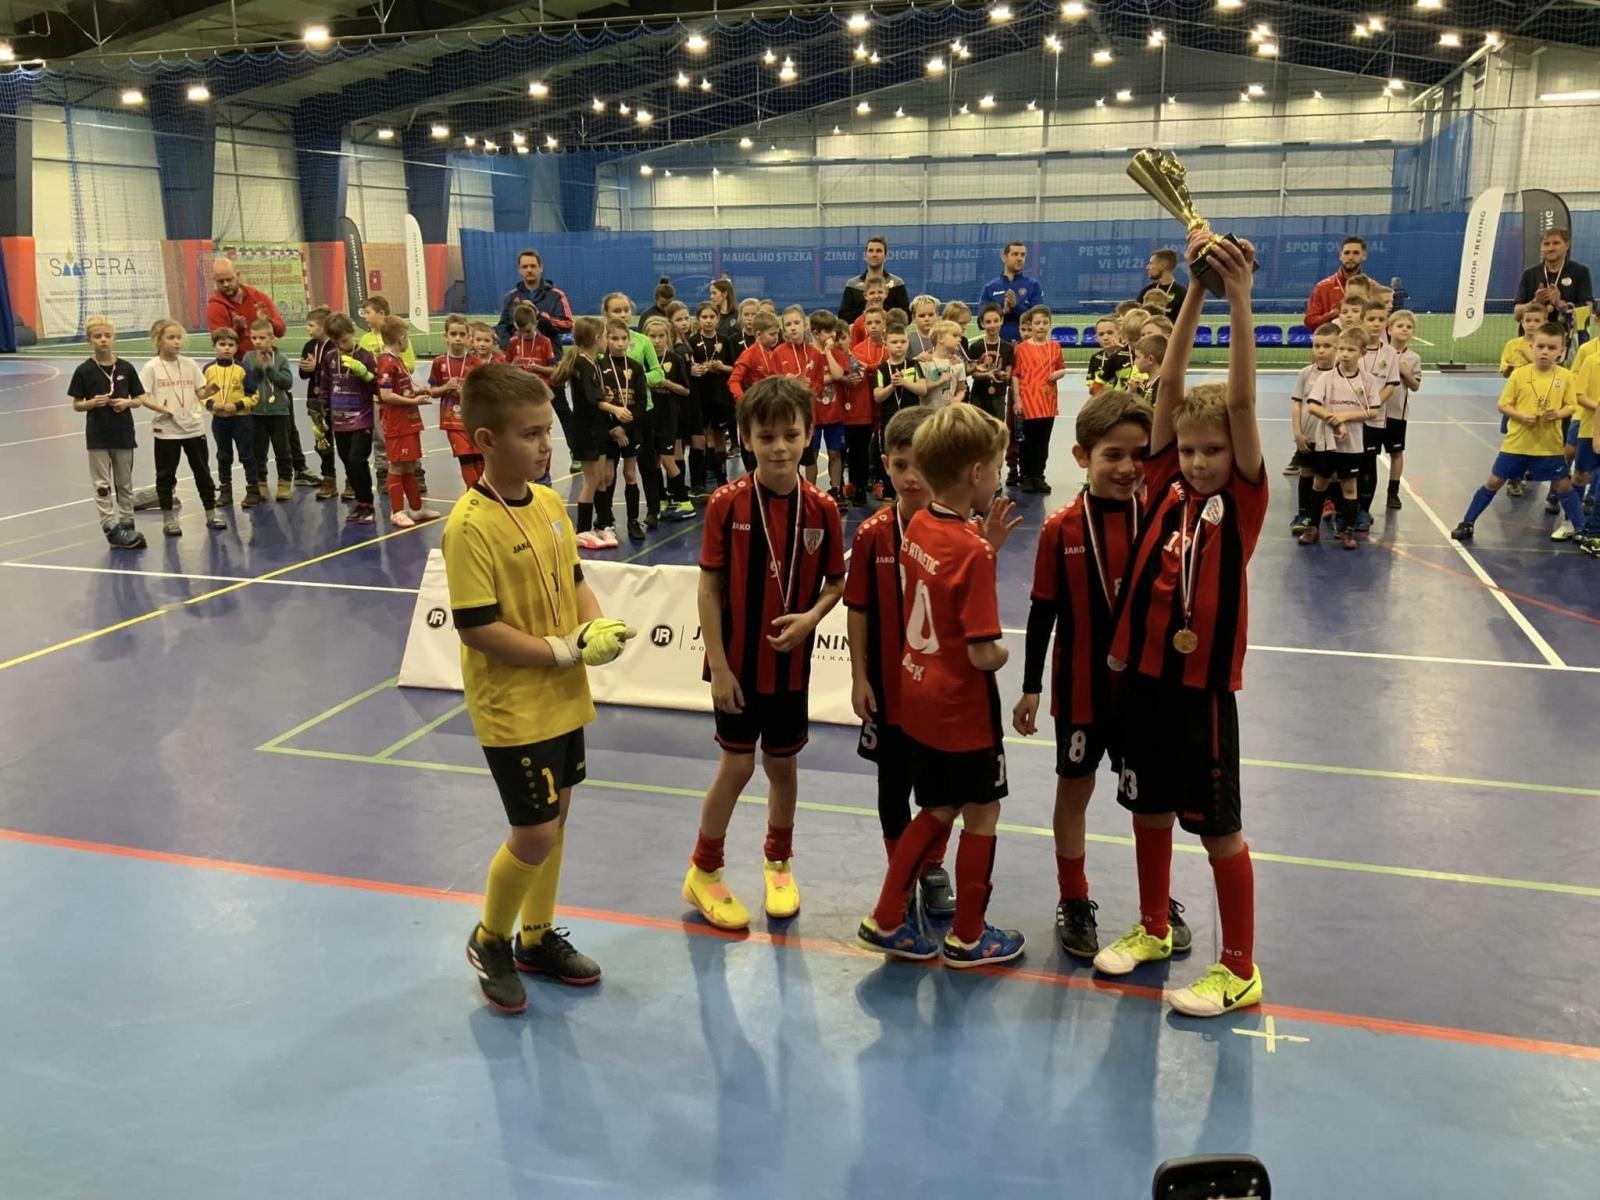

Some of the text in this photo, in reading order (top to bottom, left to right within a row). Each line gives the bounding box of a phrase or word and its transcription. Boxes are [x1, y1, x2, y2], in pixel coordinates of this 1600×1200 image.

[823, 250, 858, 261] ZIMN
[1467, 260, 1477, 298] JUNIOR
[1473, 210, 1486, 256] TRENING
[732, 521, 751, 531] JAKO
[1064, 546, 1085, 555] JAKO
[875, 555, 895, 564] JAKO
[861, 723, 878, 751] 5
[1068, 729, 1087, 764] 8
[541, 767, 559, 805] 1
[522, 921, 552, 932] JAKO
